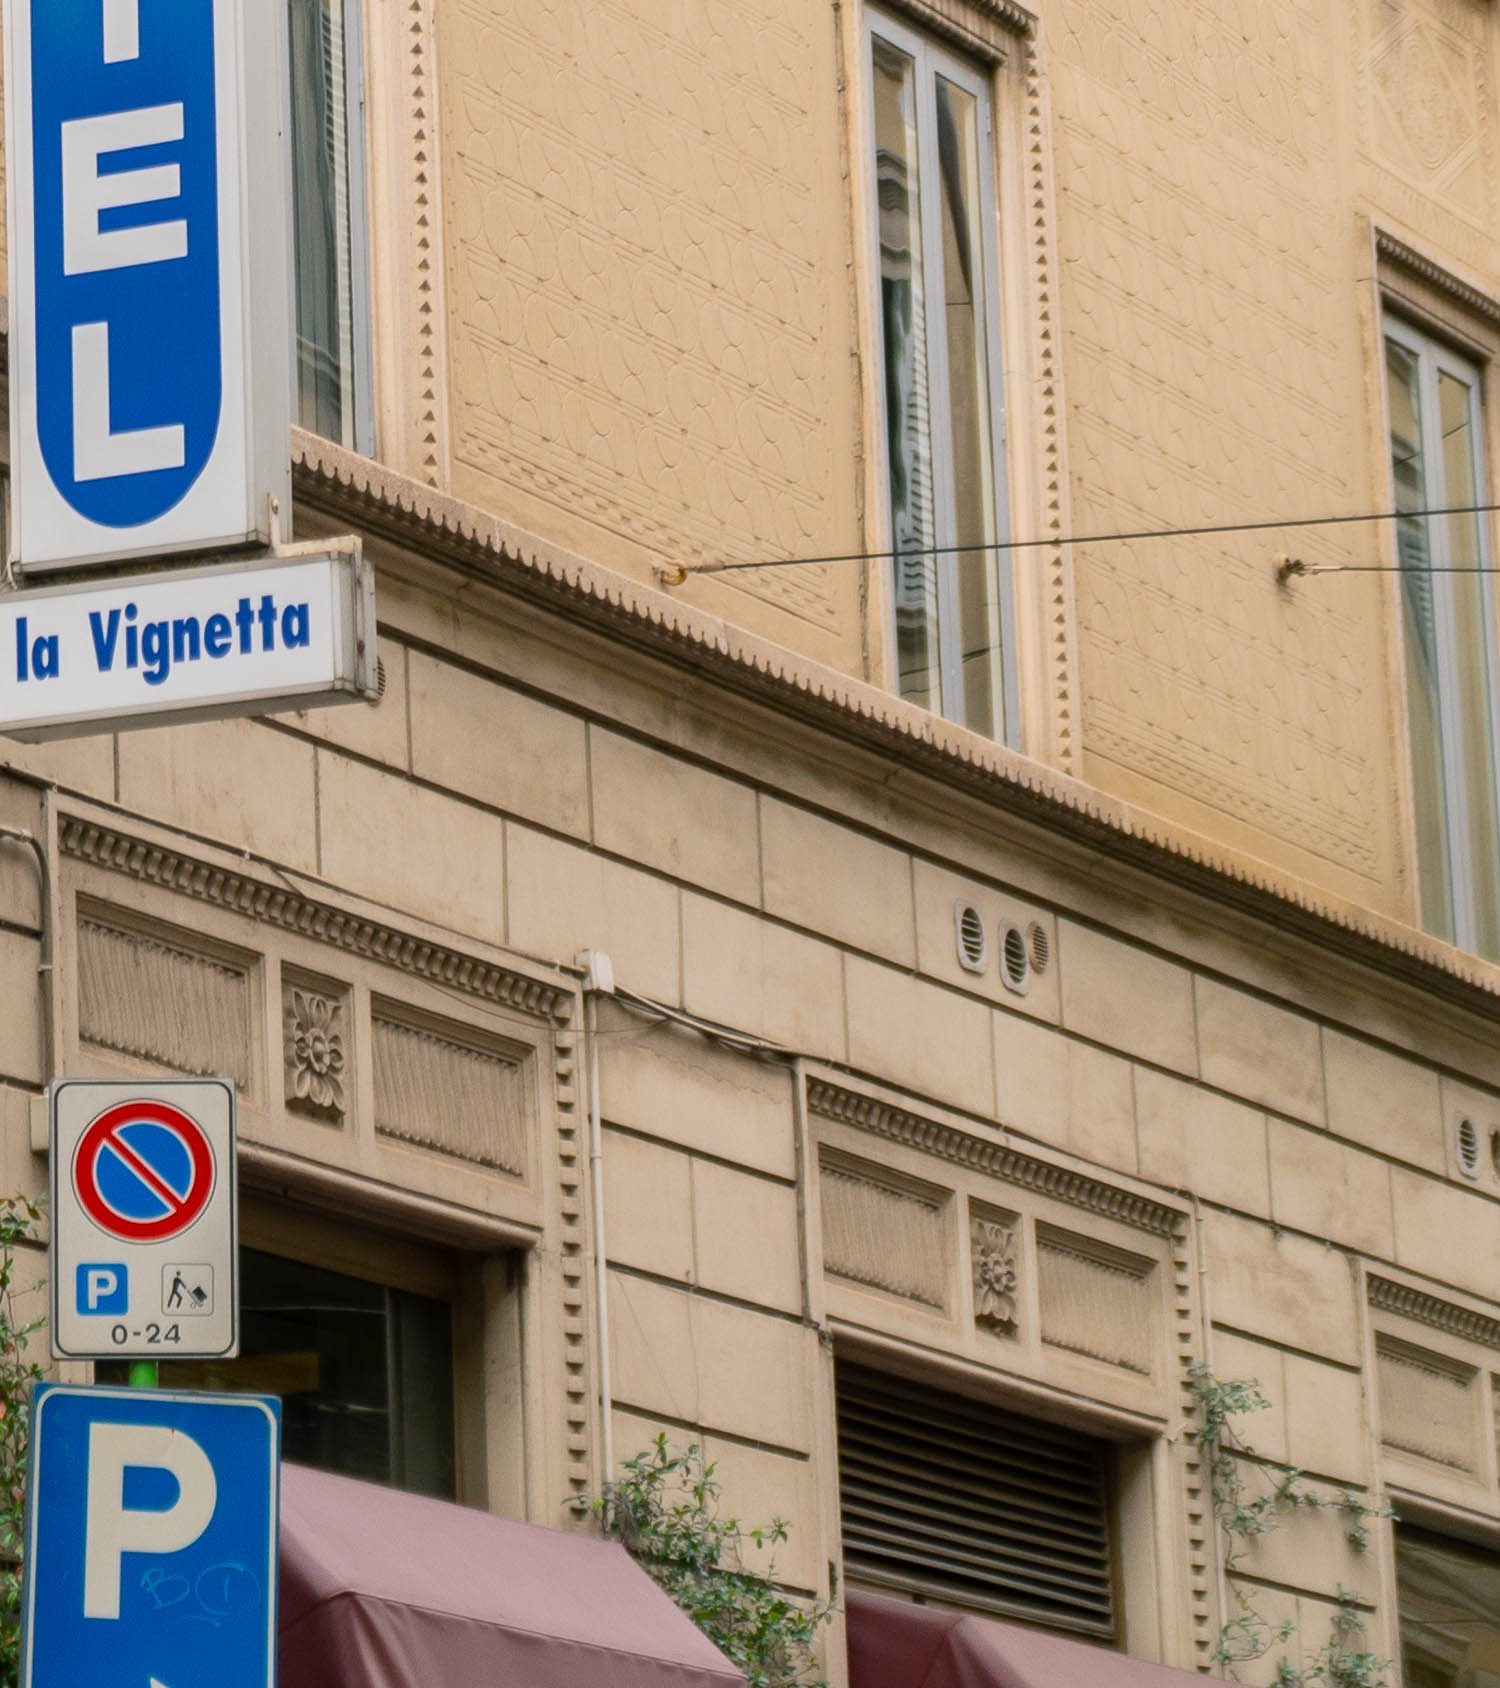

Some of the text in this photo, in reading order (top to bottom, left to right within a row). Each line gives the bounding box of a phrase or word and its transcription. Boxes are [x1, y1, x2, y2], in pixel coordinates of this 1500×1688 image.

[15, 594, 311, 686] la Vignetta
[87, 1271, 118, 1310] P
[111, 1324, 182, 1346] 0-24
[84, 1422, 217, 1619] P
